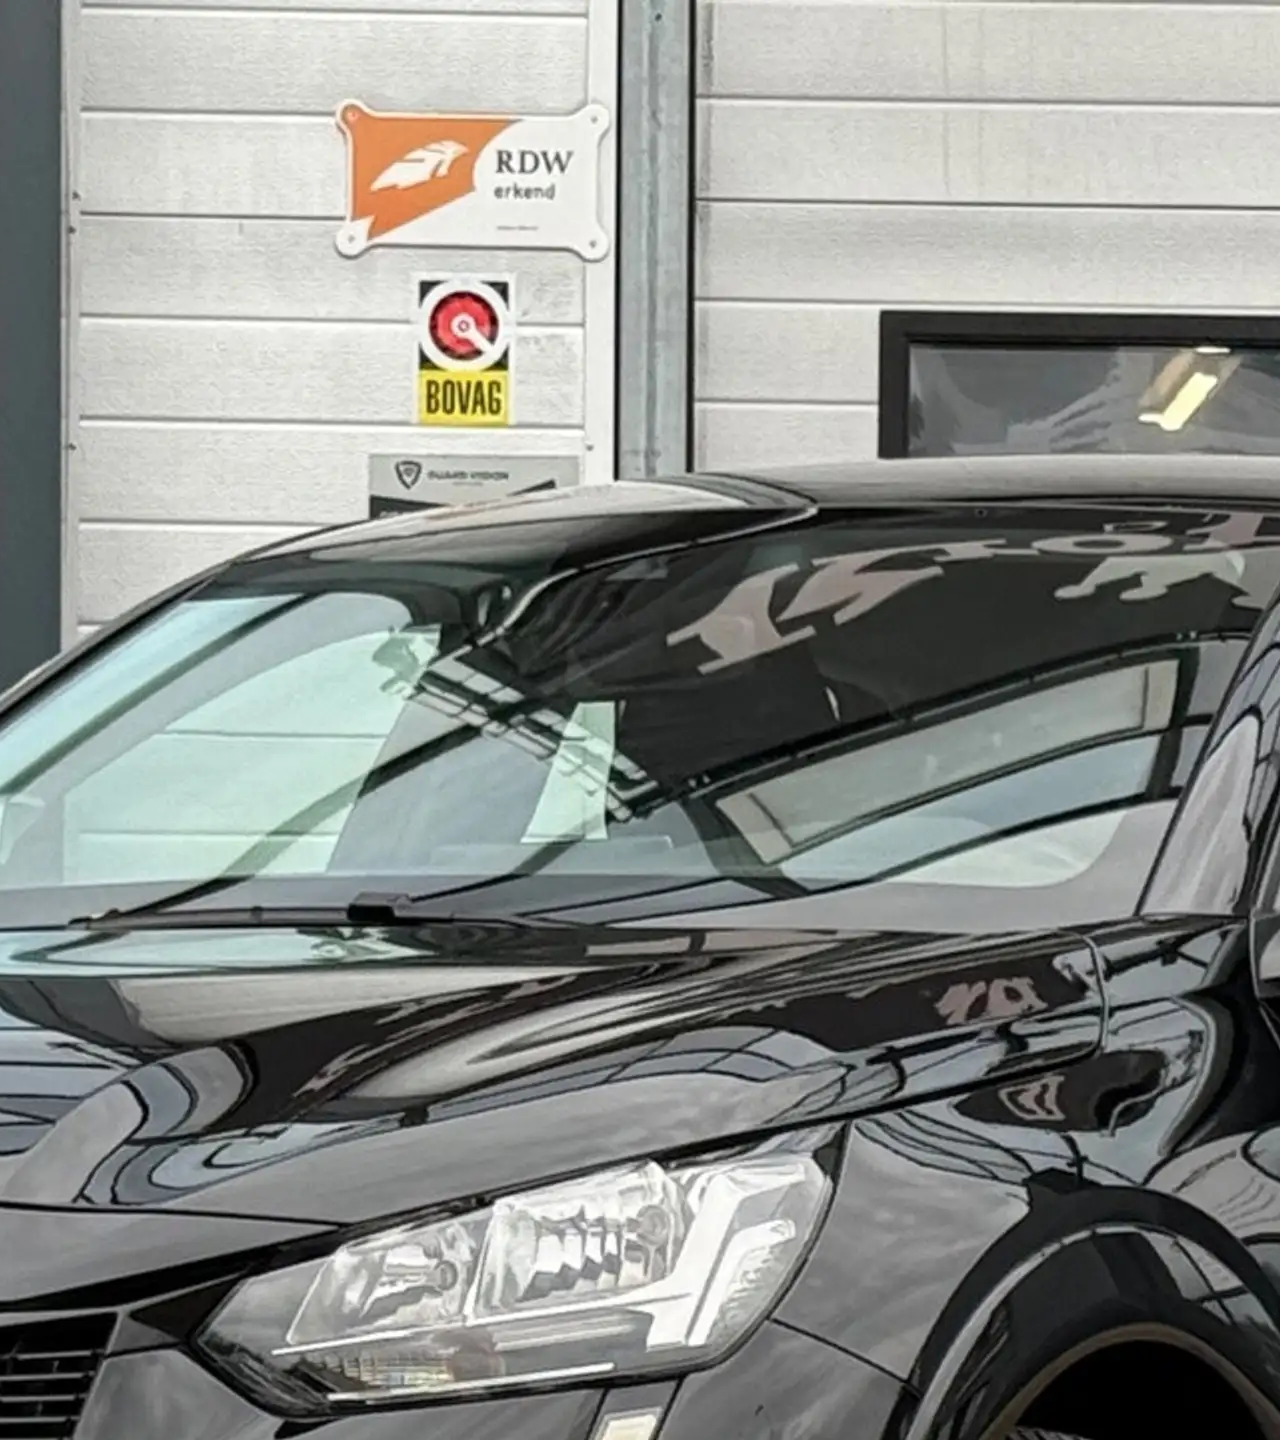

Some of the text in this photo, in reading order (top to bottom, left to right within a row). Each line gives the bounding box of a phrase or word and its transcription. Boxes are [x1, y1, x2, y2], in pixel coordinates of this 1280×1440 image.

[495, 149, 574, 175] RDW
[494, 182, 556, 200] erkend
[425, 379, 502, 417] BOVAG
